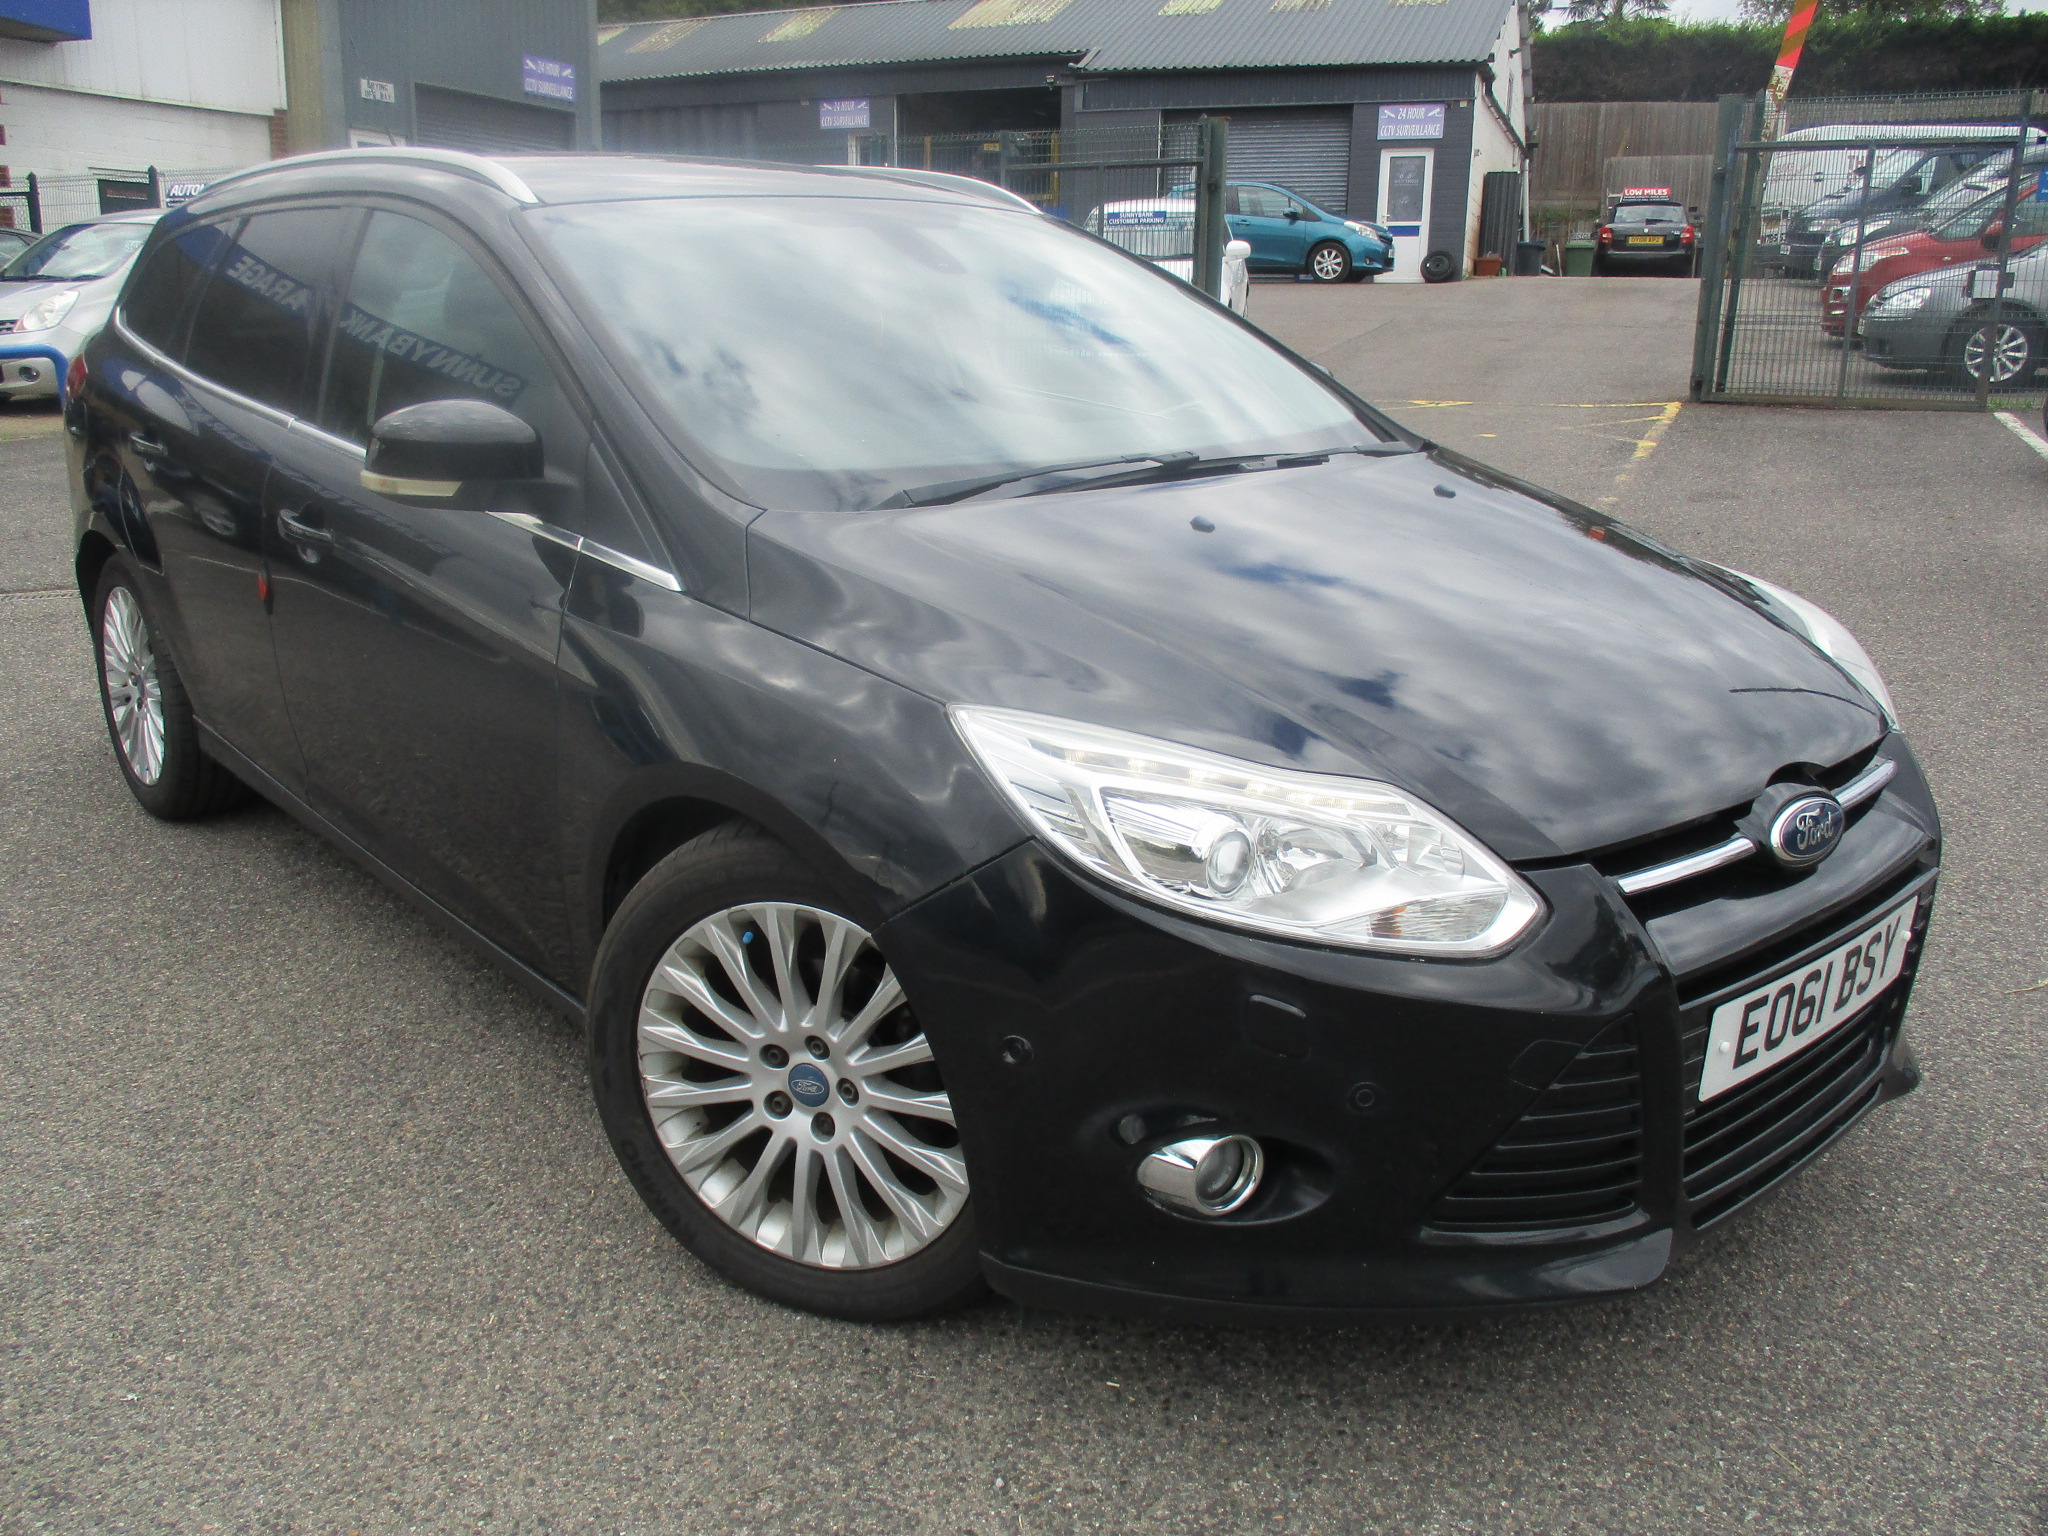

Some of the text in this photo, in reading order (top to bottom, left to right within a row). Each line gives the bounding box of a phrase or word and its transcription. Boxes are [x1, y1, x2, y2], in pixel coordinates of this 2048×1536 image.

[833, 101, 855, 111] 24 HOUR
[1397, 107, 1426, 119] 24 HOUR
[821, 114, 867, 127] CCTV SURVEILLANCE
[1380, 123, 1441, 137] CCTV SURVEILLANCE
[1624, 188, 1668, 196] LOW MILES
[1119, 211, 1154, 219] SUNNYBANK
[1796, 807, 1835, 850] Ford
[1732, 914, 1902, 1071] EO61 BSY
[796, 1081, 818, 1093] Ford
